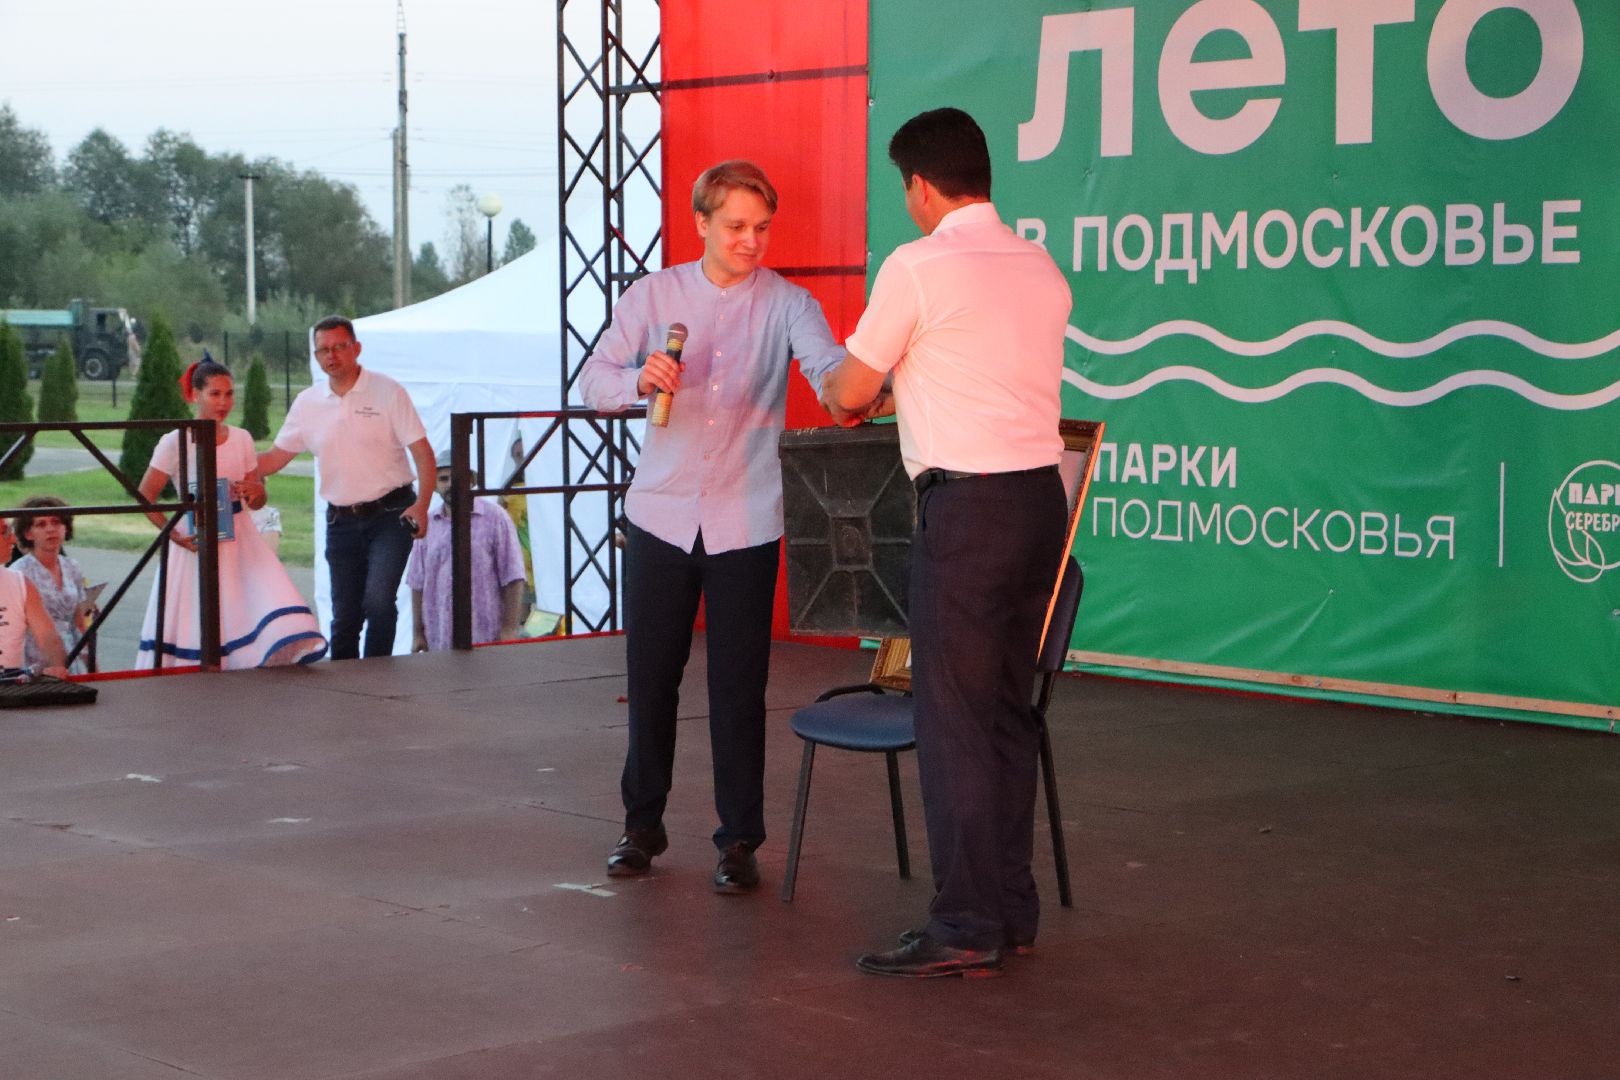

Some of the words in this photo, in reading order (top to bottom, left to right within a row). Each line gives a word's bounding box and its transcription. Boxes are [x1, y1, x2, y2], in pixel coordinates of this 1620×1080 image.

[1073, 200, 1581, 284] ПОДМОСКОВЬЕ
[1094, 443, 1237, 488] ПАРКИ
[1093, 497, 1454, 559] ПОДМОСКОВЬЯ
